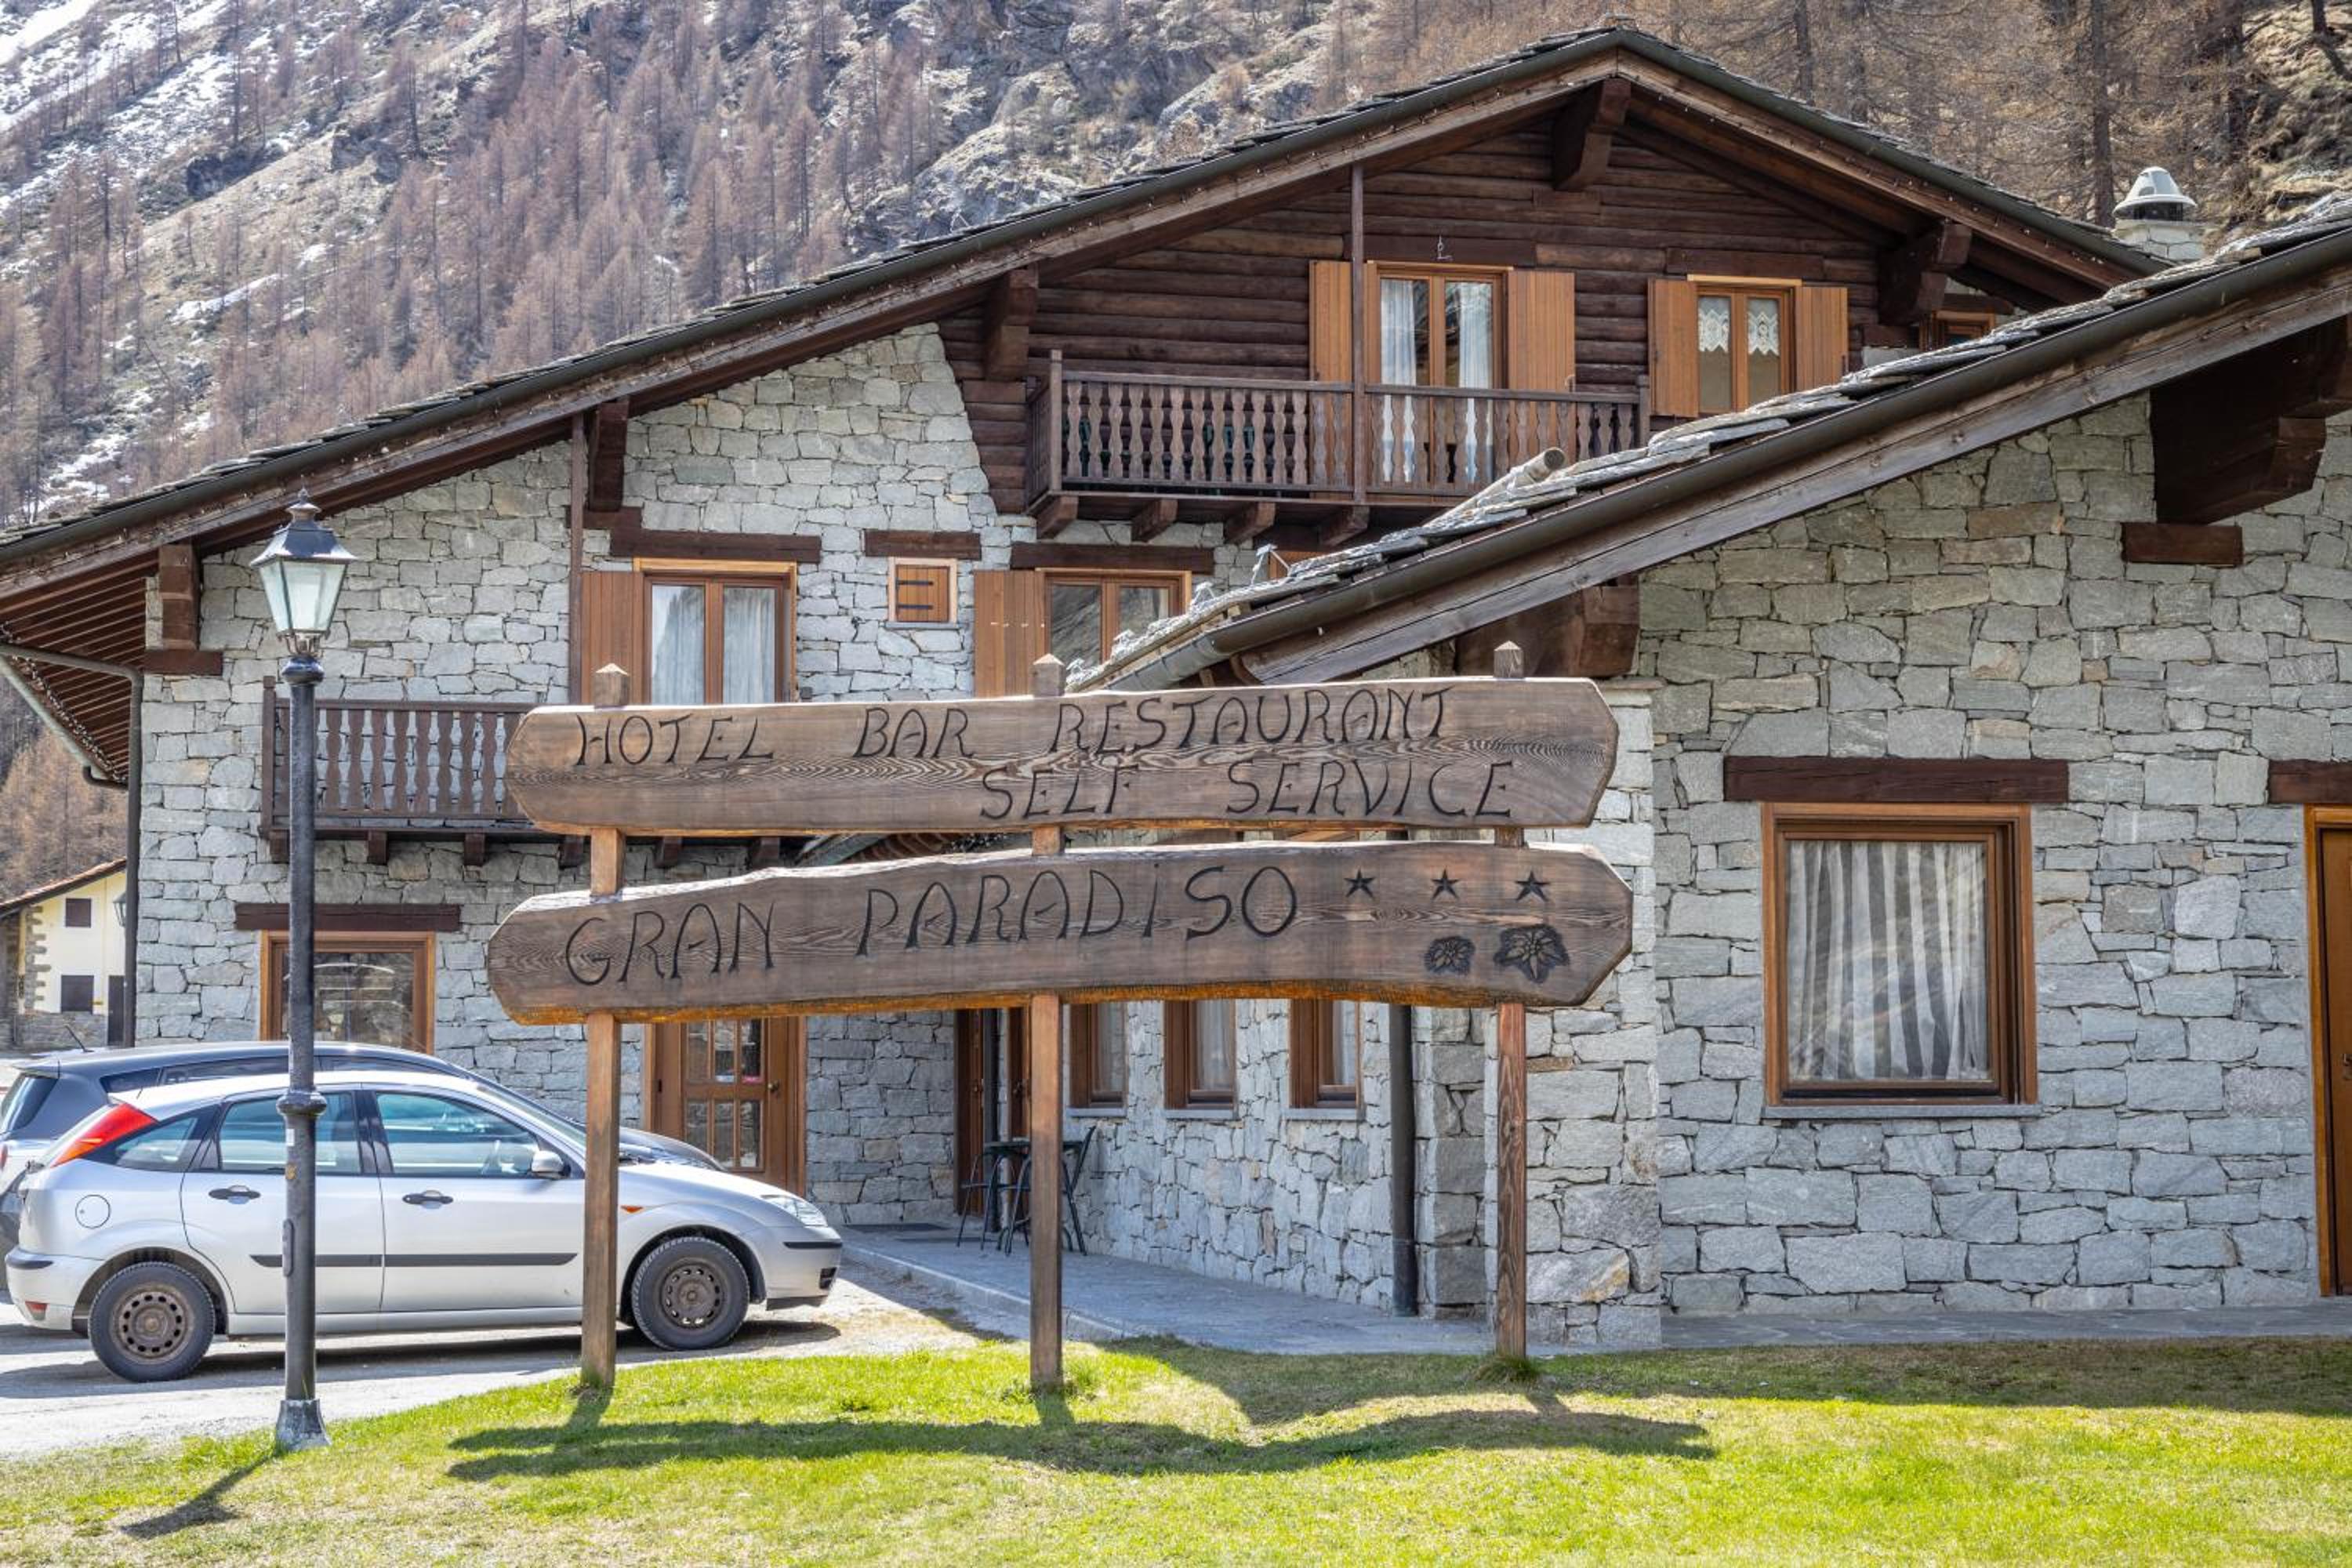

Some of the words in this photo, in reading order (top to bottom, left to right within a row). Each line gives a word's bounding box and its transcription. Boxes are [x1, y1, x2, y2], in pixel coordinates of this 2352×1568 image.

[576, 713, 774, 765] HOTEL
[855, 707, 975, 758] BAR
[1051, 686, 1455, 753] RESTAURANT
[981, 764, 1140, 819] SELF
[1227, 760, 1512, 818] SERVICE
[566, 902, 776, 985] GRAN
